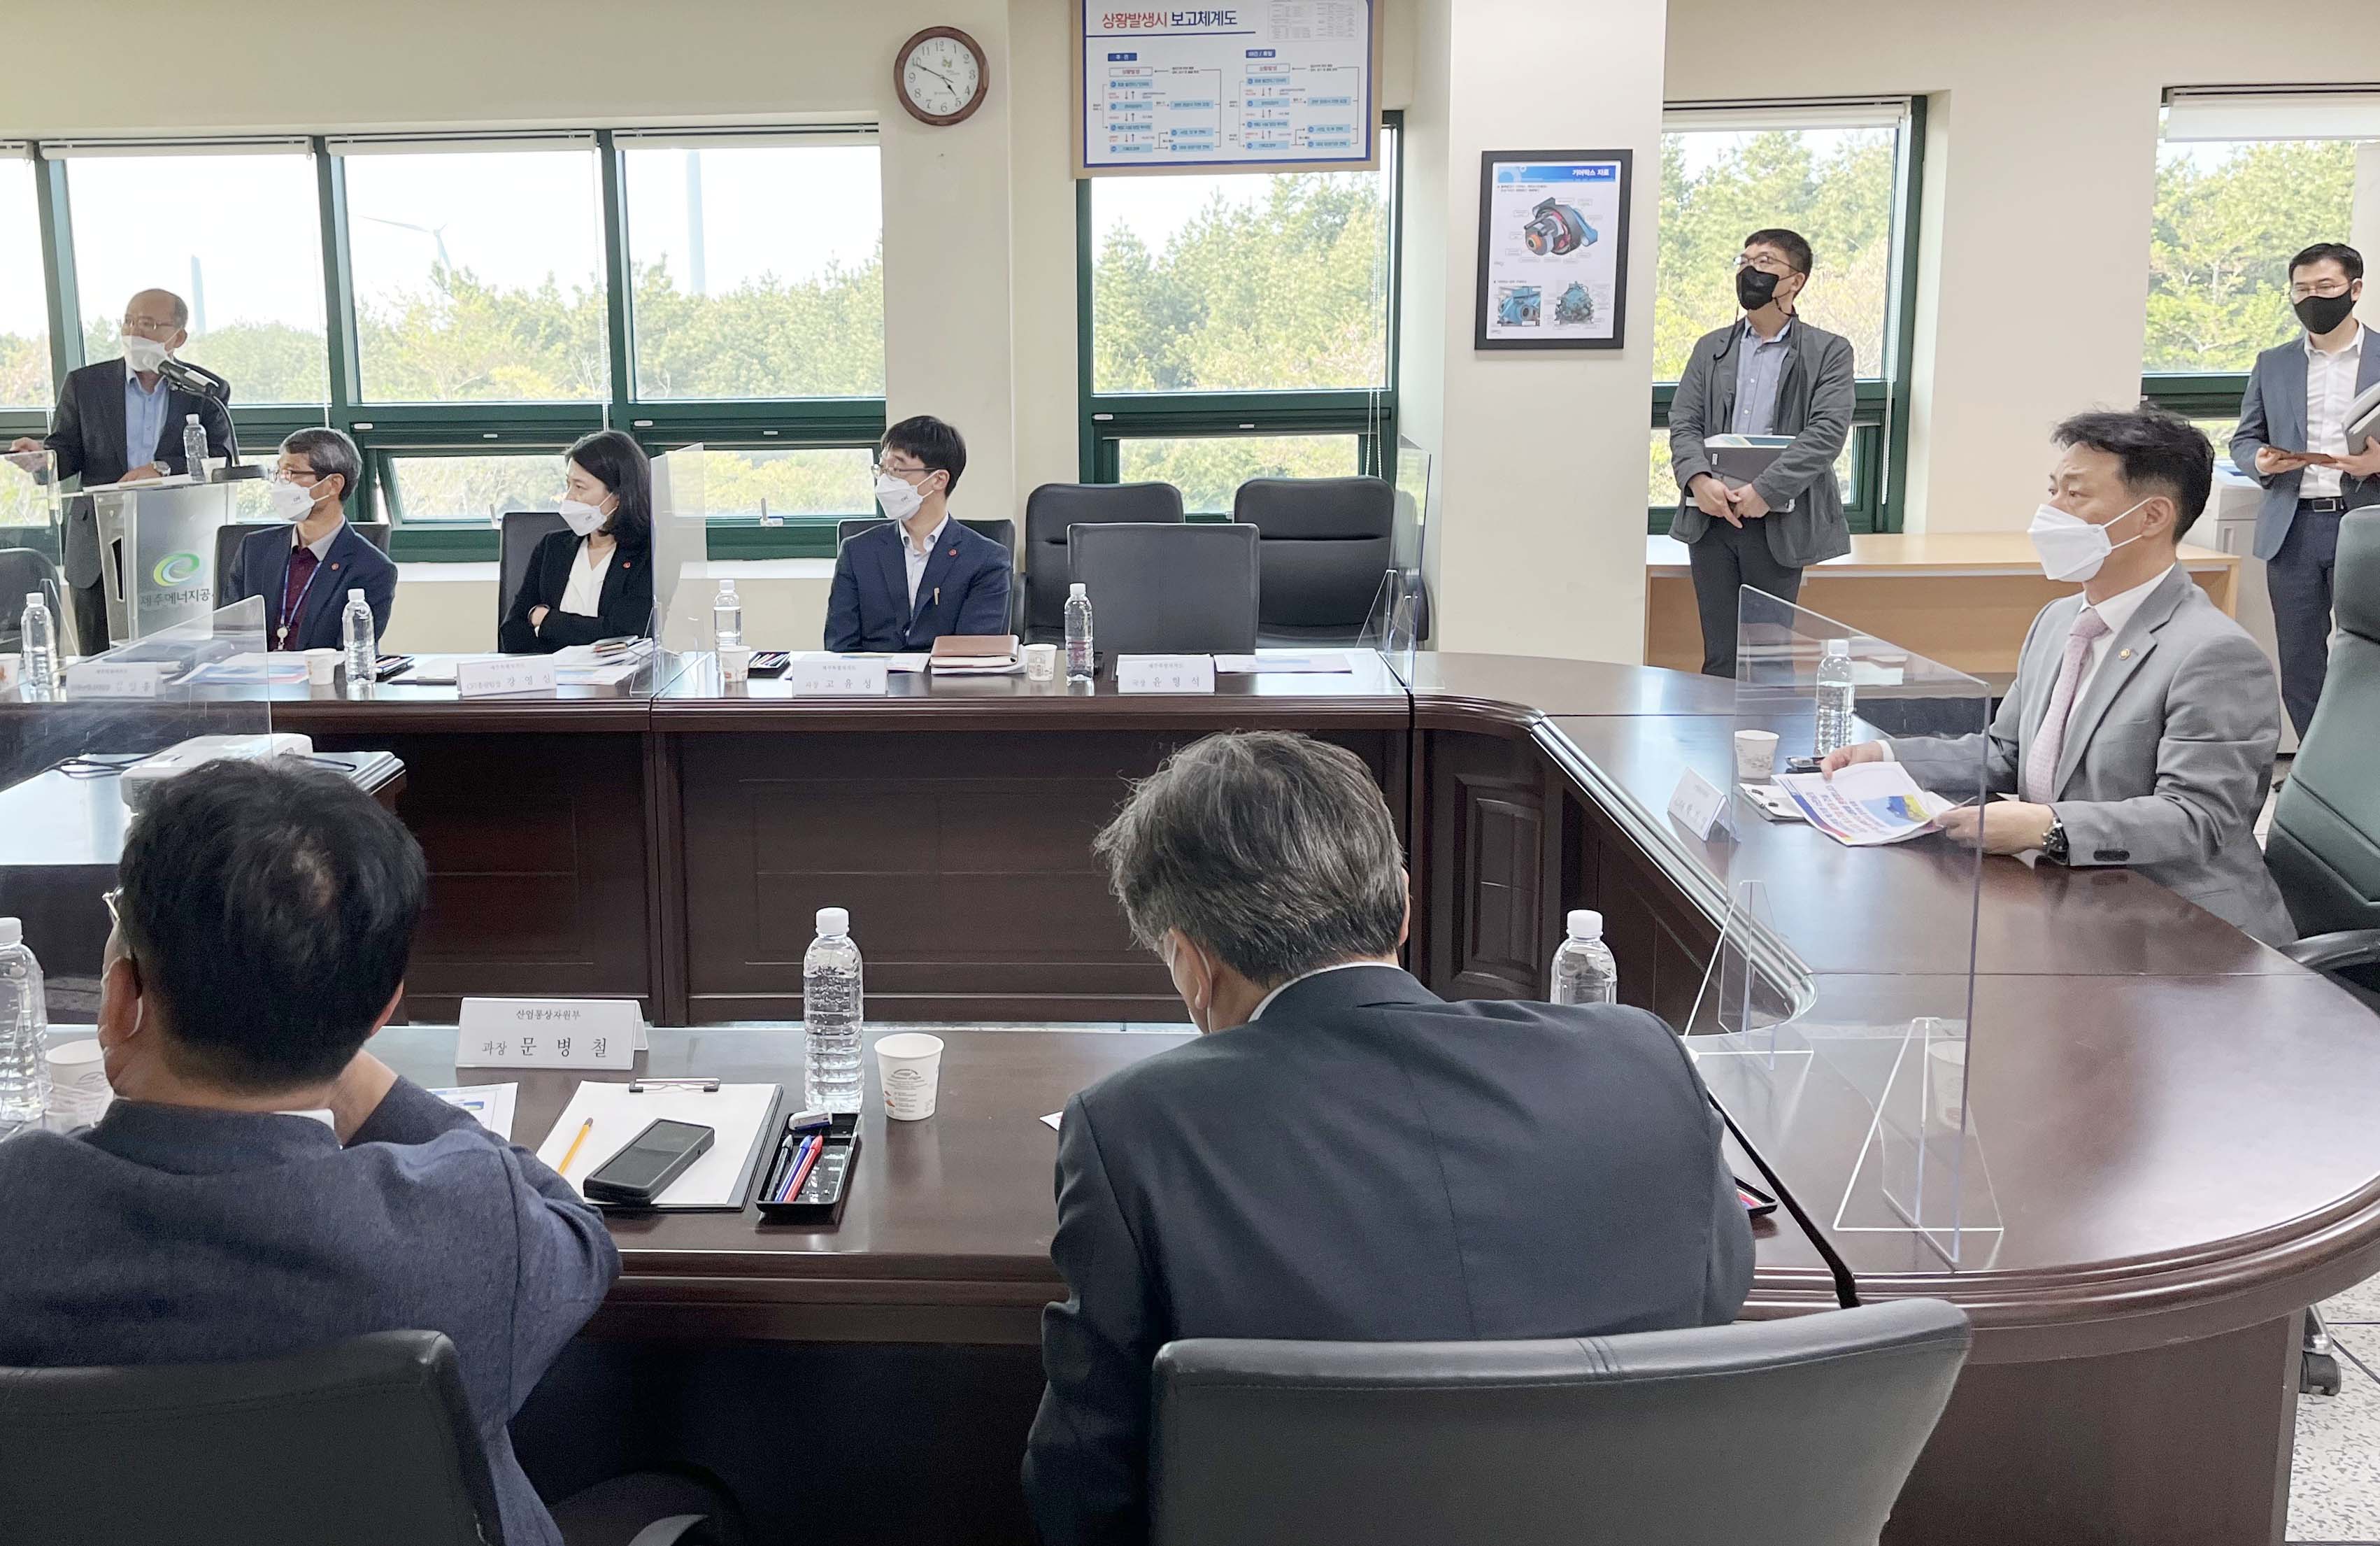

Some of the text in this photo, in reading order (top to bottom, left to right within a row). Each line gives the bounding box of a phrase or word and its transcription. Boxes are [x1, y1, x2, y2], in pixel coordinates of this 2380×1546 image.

[1102, 10, 1238, 29] 상황발생시 보고체계도
[922, 45, 930, 57] 11
[935, 41, 945, 52] 12
[953, 44, 957, 54] 1
[963, 54, 970, 64] 2
[908, 72, 916, 83] 9
[969, 69, 976, 80] 3
[914, 88, 922, 99] 8
[964, 85, 971, 96] 4
[926, 99, 932, 109] 7
[941, 102, 948, 113] 6
[955, 98, 962, 107] 5
[140, 588, 214, 607] 제주에너지공
[515, 1009, 582, 1021] 산업통상자원부
[481, 1037, 607, 1059] 과장 문 병 철
